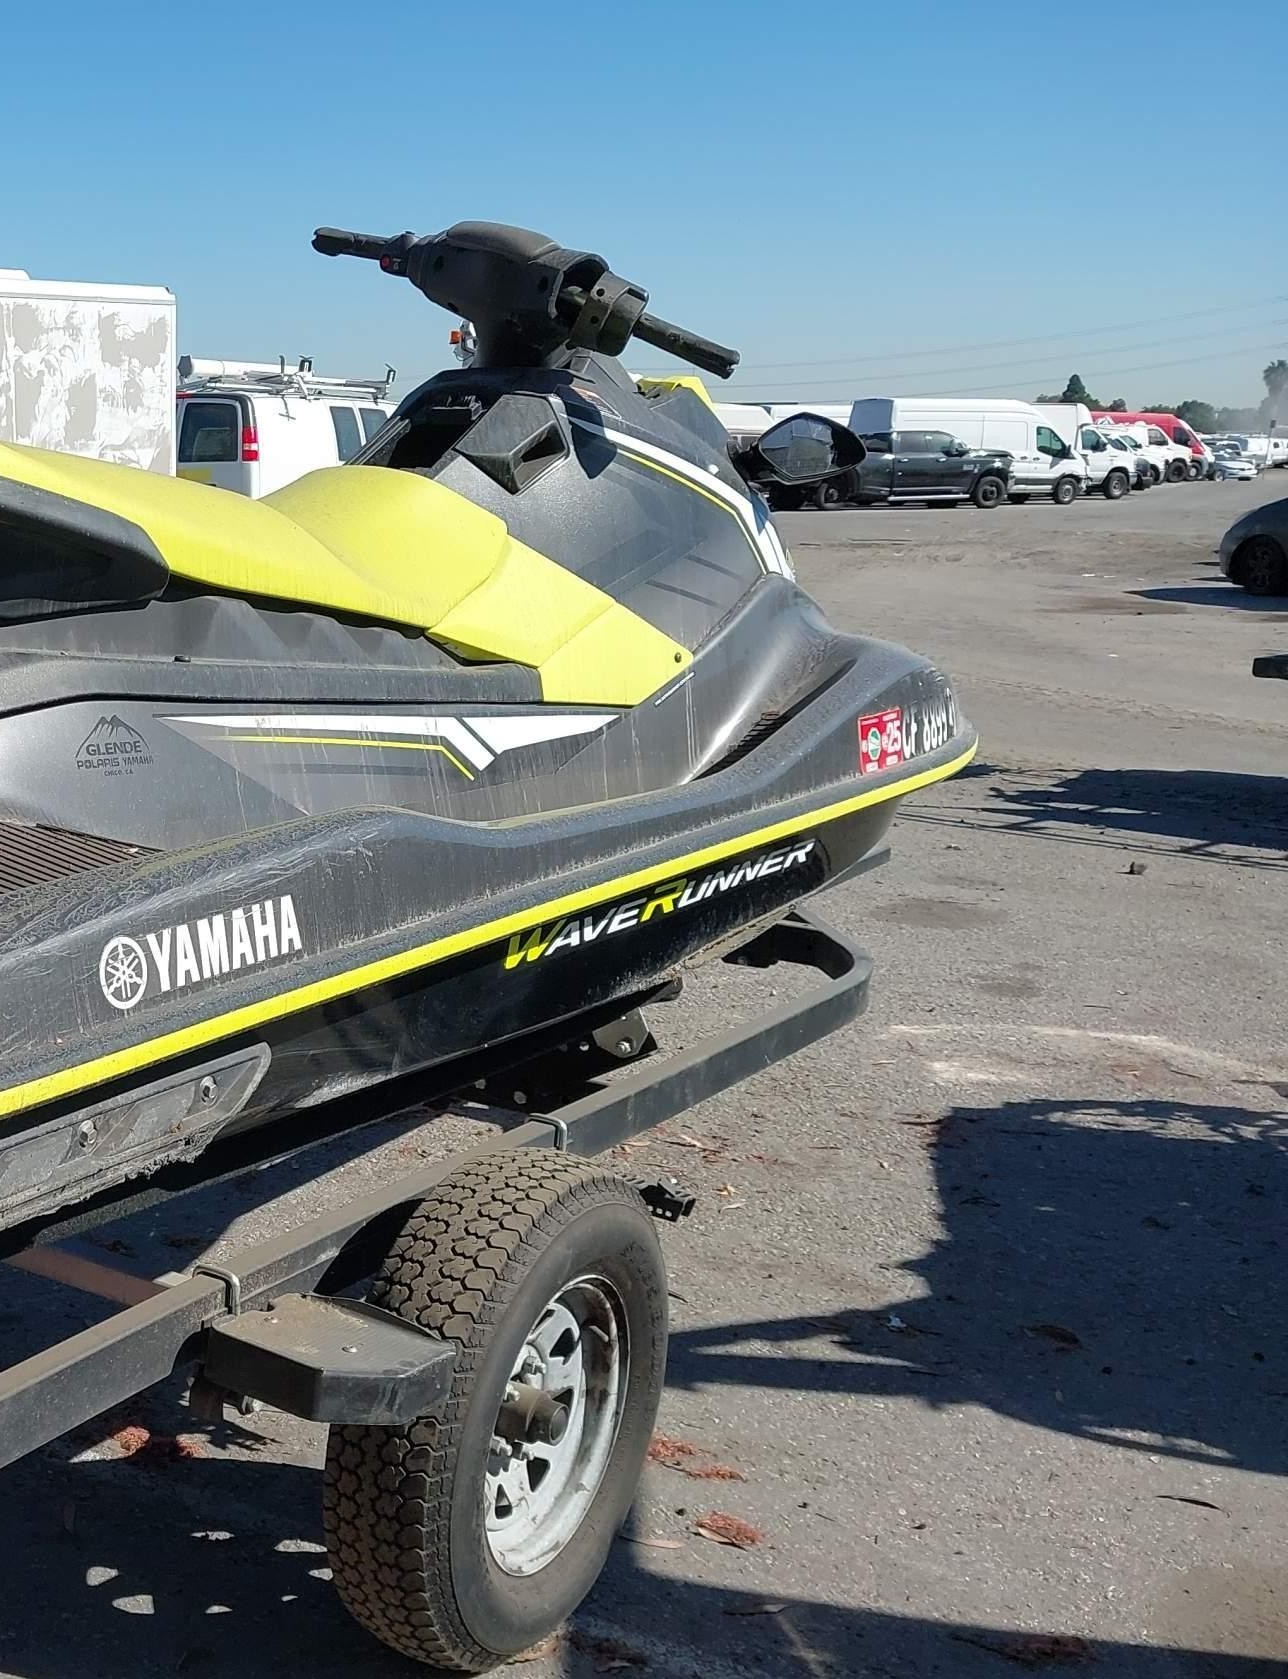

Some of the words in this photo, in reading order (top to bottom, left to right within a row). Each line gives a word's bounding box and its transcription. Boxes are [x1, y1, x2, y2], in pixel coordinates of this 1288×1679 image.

[85, 740, 143, 756] GLENDE
[886, 719, 902, 753] 25
[76, 757, 120, 770] POLARIS
[122, 755, 154, 767] YAMAHA
[504, 838, 816, 970] WAVERUNNER
[145, 894, 303, 993] YAMAHA
